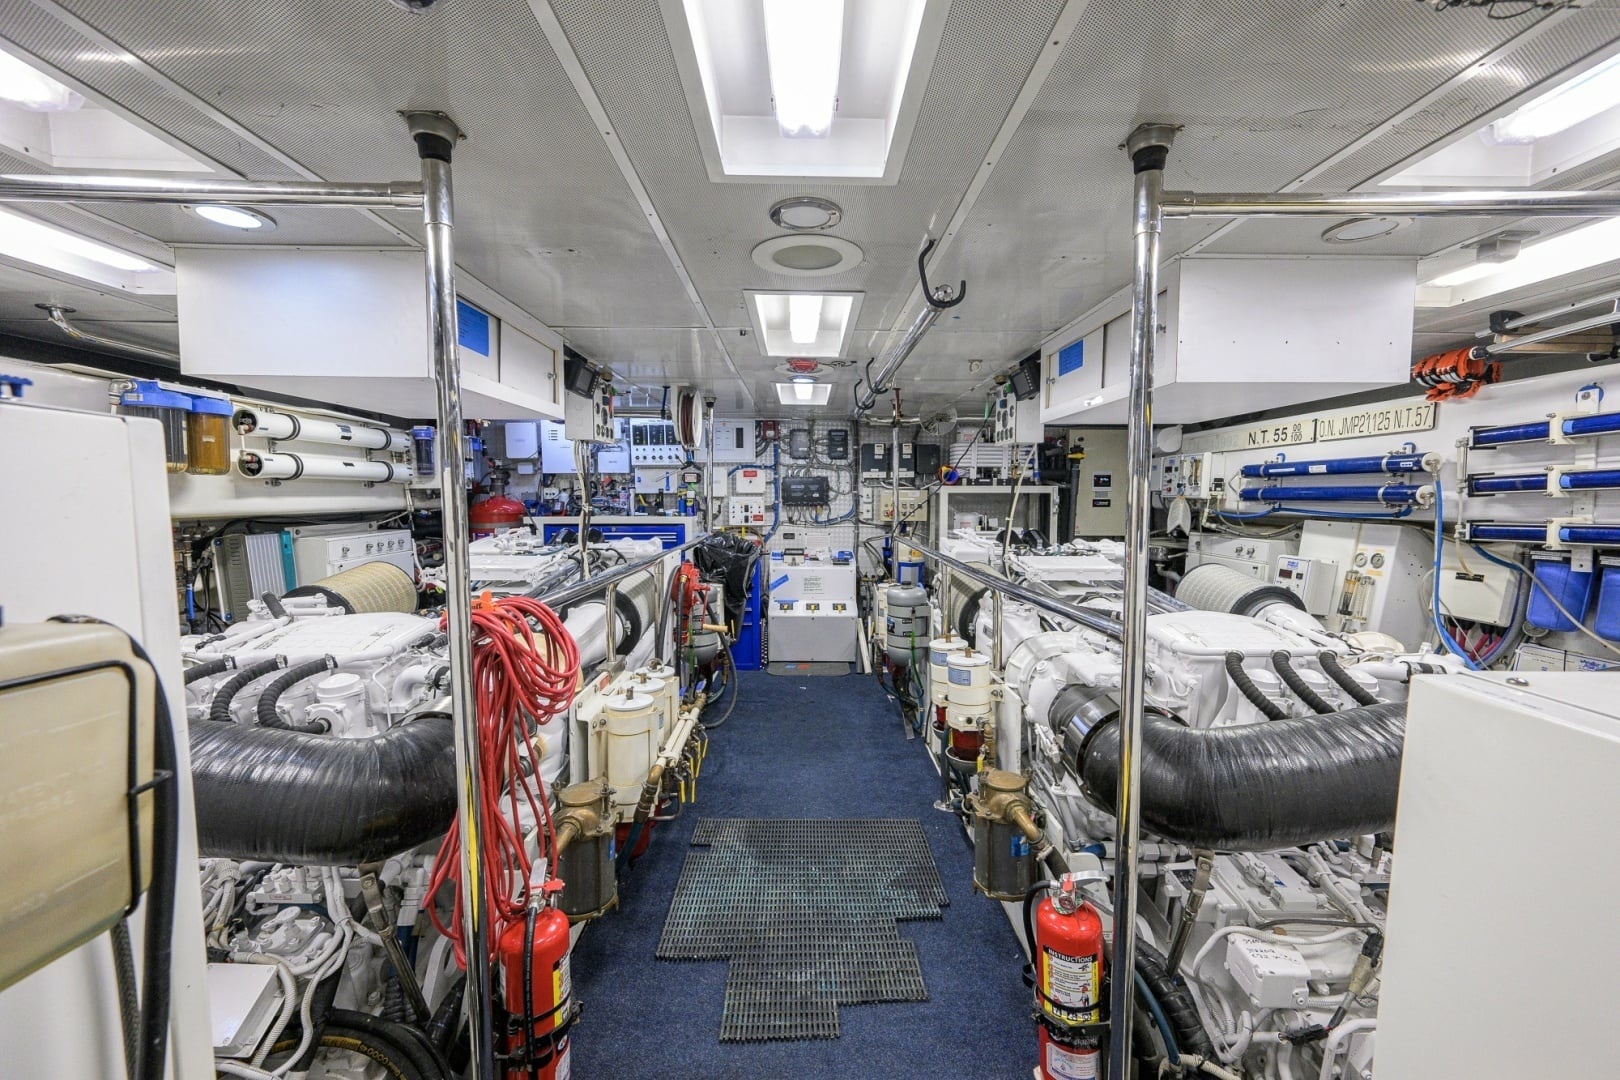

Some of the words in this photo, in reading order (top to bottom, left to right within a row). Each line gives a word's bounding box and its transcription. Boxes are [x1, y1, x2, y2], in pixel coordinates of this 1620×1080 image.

[1338, 411, 1391, 436] JMP21125
[1248, 429, 1270, 446] N.T.
[1273, 427, 1288, 442] 55
[1048, 948, 1093, 964] INSTRUCTIONS
